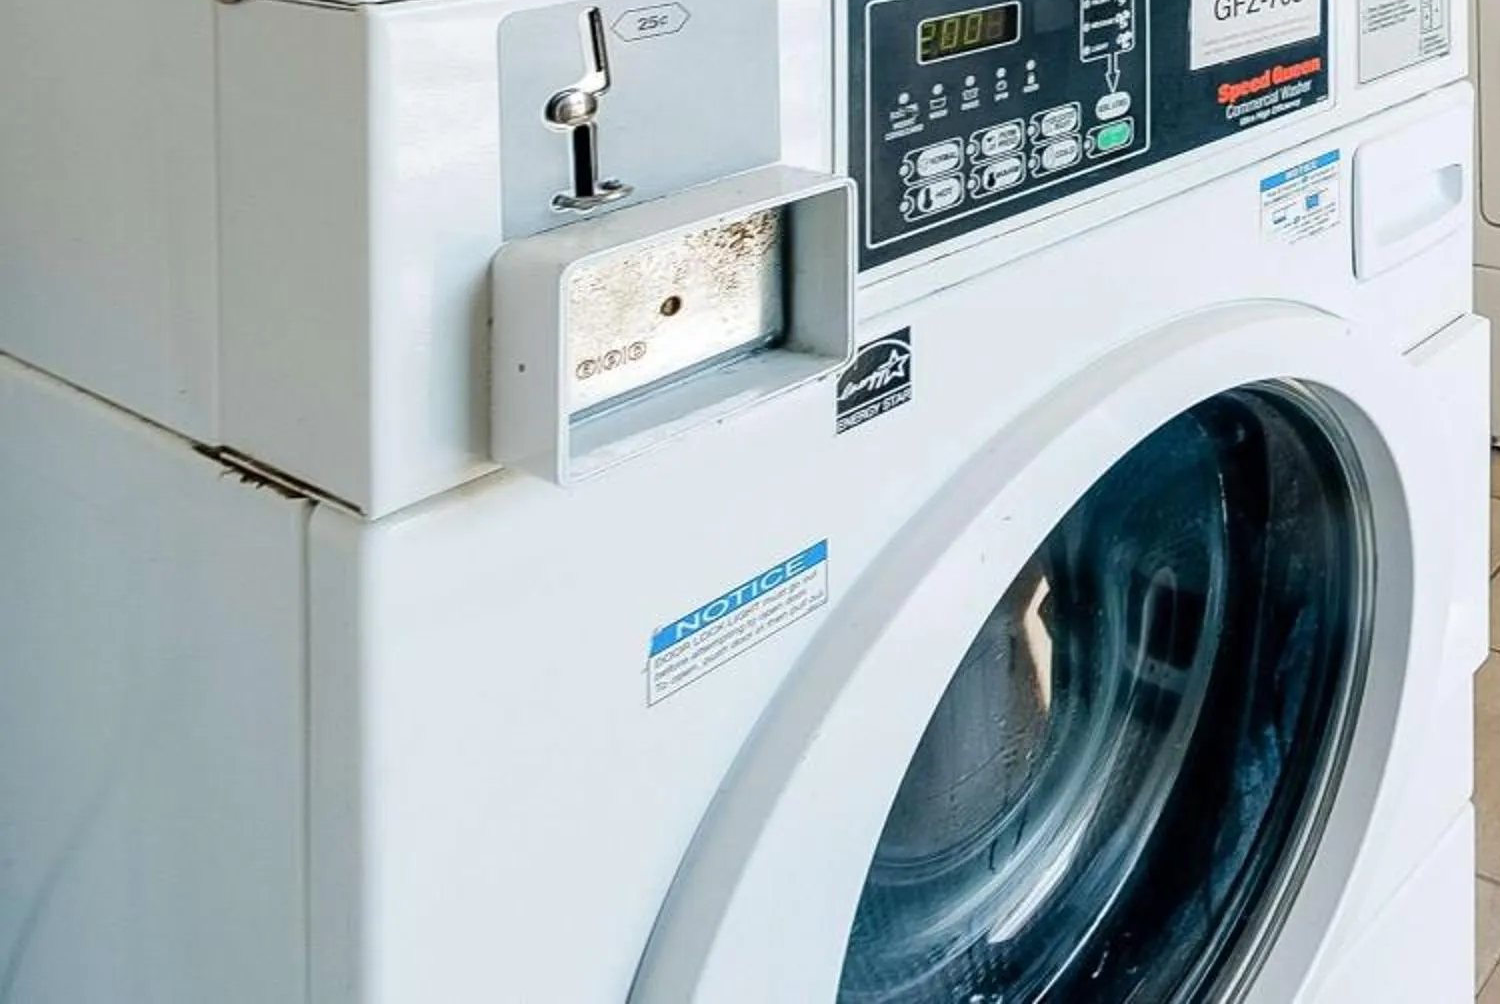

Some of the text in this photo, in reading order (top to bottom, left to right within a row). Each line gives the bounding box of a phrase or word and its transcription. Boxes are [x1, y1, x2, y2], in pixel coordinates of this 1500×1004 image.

[1217, 56, 1321, 104] Speed Queen
[1225, 88, 1280, 120] Commercial
[835, 384, 912, 434] ENERGY STAR
[675, 554, 809, 640] NOTICE
